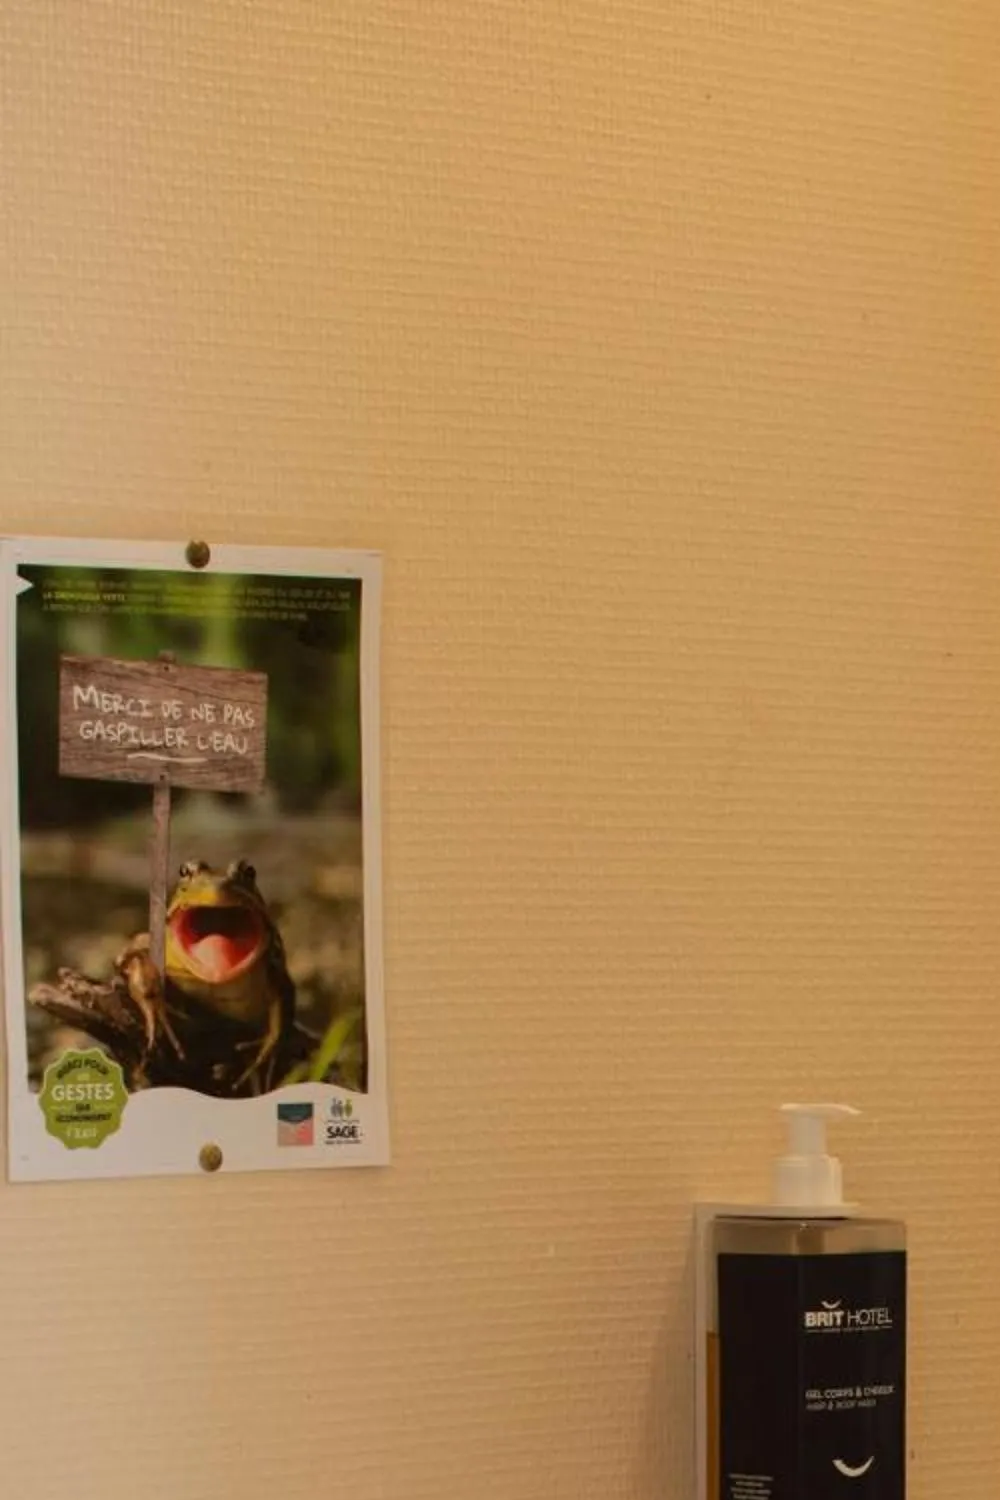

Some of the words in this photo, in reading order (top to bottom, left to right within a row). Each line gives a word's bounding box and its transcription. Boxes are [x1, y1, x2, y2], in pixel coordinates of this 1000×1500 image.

[72, 684, 151, 719] MERCI
[161, 701, 182, 721] DE
[191, 702, 216, 723] NE
[223, 703, 255, 729] PAS
[79, 720, 189, 749] GASPILLER
[197, 731, 248, 755] L'EAU
[51, 1083, 114, 1101] GESTES
[326, 1125, 359, 1139] SAGE
[804, 1311, 844, 1328] BRIT
[847, 1307, 893, 1326] HOTEL
